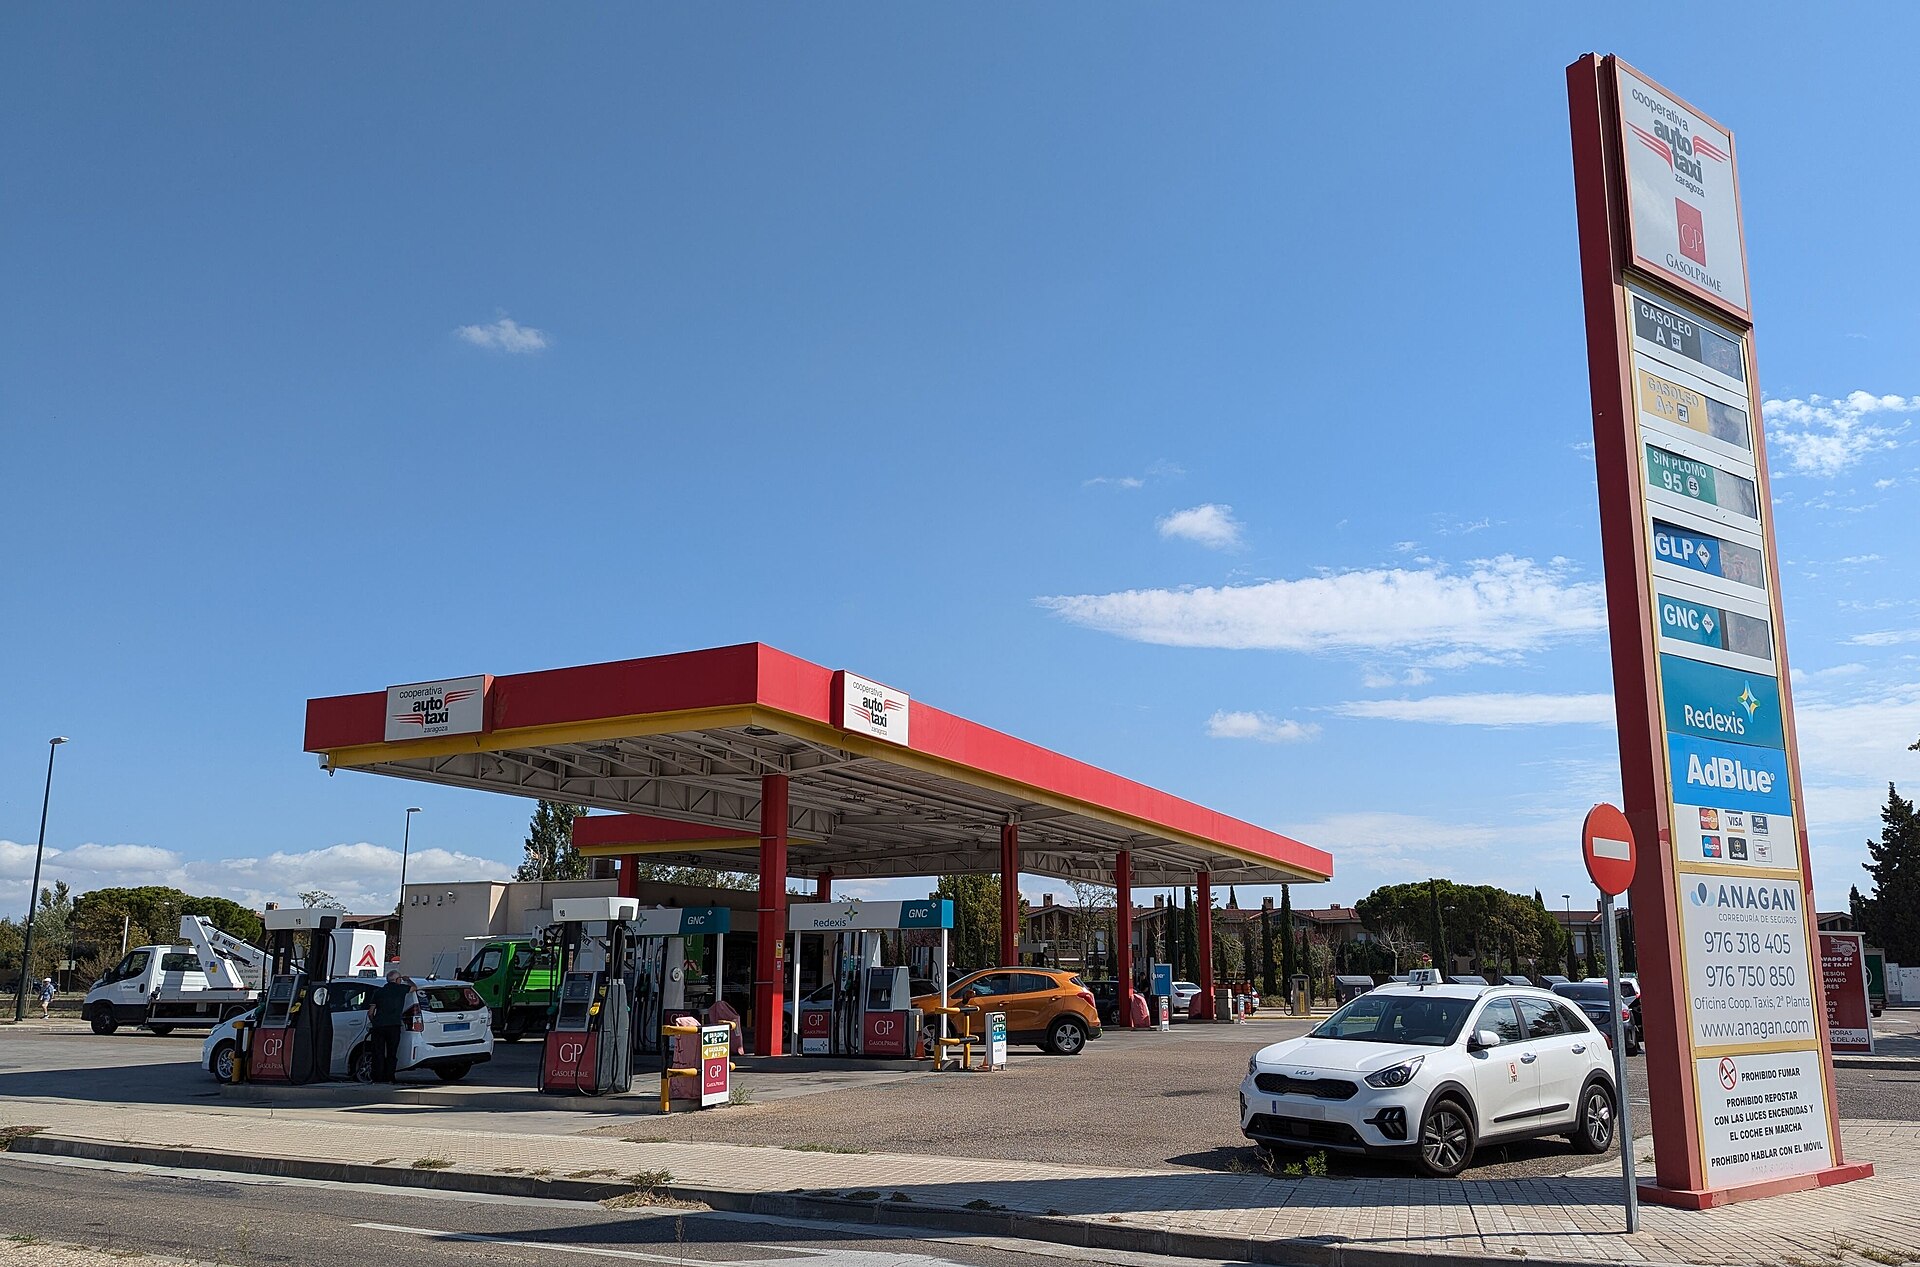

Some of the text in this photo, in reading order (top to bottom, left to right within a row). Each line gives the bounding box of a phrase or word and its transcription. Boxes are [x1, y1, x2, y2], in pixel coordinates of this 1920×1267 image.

[1632, 88, 1689, 132] cooperativa
[1653, 119, 1692, 153] auto
[1672, 150, 1704, 184] taxi
[1675, 173, 1705, 198] zaragoza
[1681, 223, 1703, 252] GP
[1665, 253, 1722, 293] GASOLPRIME
[1641, 304, 1692, 337] GASOLEO
[1655, 327, 1680, 346] A B7
[1648, 377, 1699, 408] GASOLEO
[1656, 395, 1686, 418] A+ B7
[1653, 451, 1707, 479] SIN PLOMO
[1662, 470, 1698, 493] 95 E5
[1655, 532, 1694, 562] GLP
[1663, 603, 1700, 631] GNC
[399, 686, 443, 700] cooperativa
[852, 681, 883, 698] cooperativa
[412, 697, 443, 713] auto
[862, 696, 883, 713] auto
[424, 708, 449, 725] taxi
[871, 711, 887, 728] taxi
[1684, 704, 1745, 735] Redexis
[423, 725, 448, 734] zaragoza
[1727, 816, 1743, 827] VISA
[1717, 884, 1796, 911] ANAGAN
[687, 916, 705, 925] GNC
[813, 908, 929, 927] Redexis GNC
[1718, 913, 1797, 924] CORREDURÍA DE SEGUROS
[1704, 931, 1791, 954] 976 318 405
[1415, 971, 1430, 982] 75
[1705, 966, 1795, 987] 976 750 850
[1694, 997, 1726, 1010] Oficina
[1728, 997, 1752, 1011] Coop.
[1753, 996, 1776, 1009] Taxis,
[1786, 996, 1810, 1008] Planta
[808, 1014, 823, 1026] GP
[875, 1020, 894, 1035] GP
[1701, 1019, 1810, 1039] www.anagan.com
[264, 1038, 283, 1056] GP
[559, 1043, 583, 1063] GP
[709, 1065, 722, 1079] GP
[1741, 1067, 1801, 1082] PROHIBIDO FUMAR
[1726, 1090, 1798, 1108] PROHIBIDO REPOSTAR
[1714, 1104, 1815, 1126] CON LAS LUCES ENCENDIDAS Y
[1729, 1122, 1802, 1142] EL COCHE EN MARCHA
[1711, 1154, 1750, 1168] PROHIBIDO
[1751, 1149, 1778, 1161] HABLAR
[1779, 1146, 1793, 1156] CON
[1794, 1145, 1803, 1154] EL
[1804, 1140, 1823, 1152] MÓVIL
